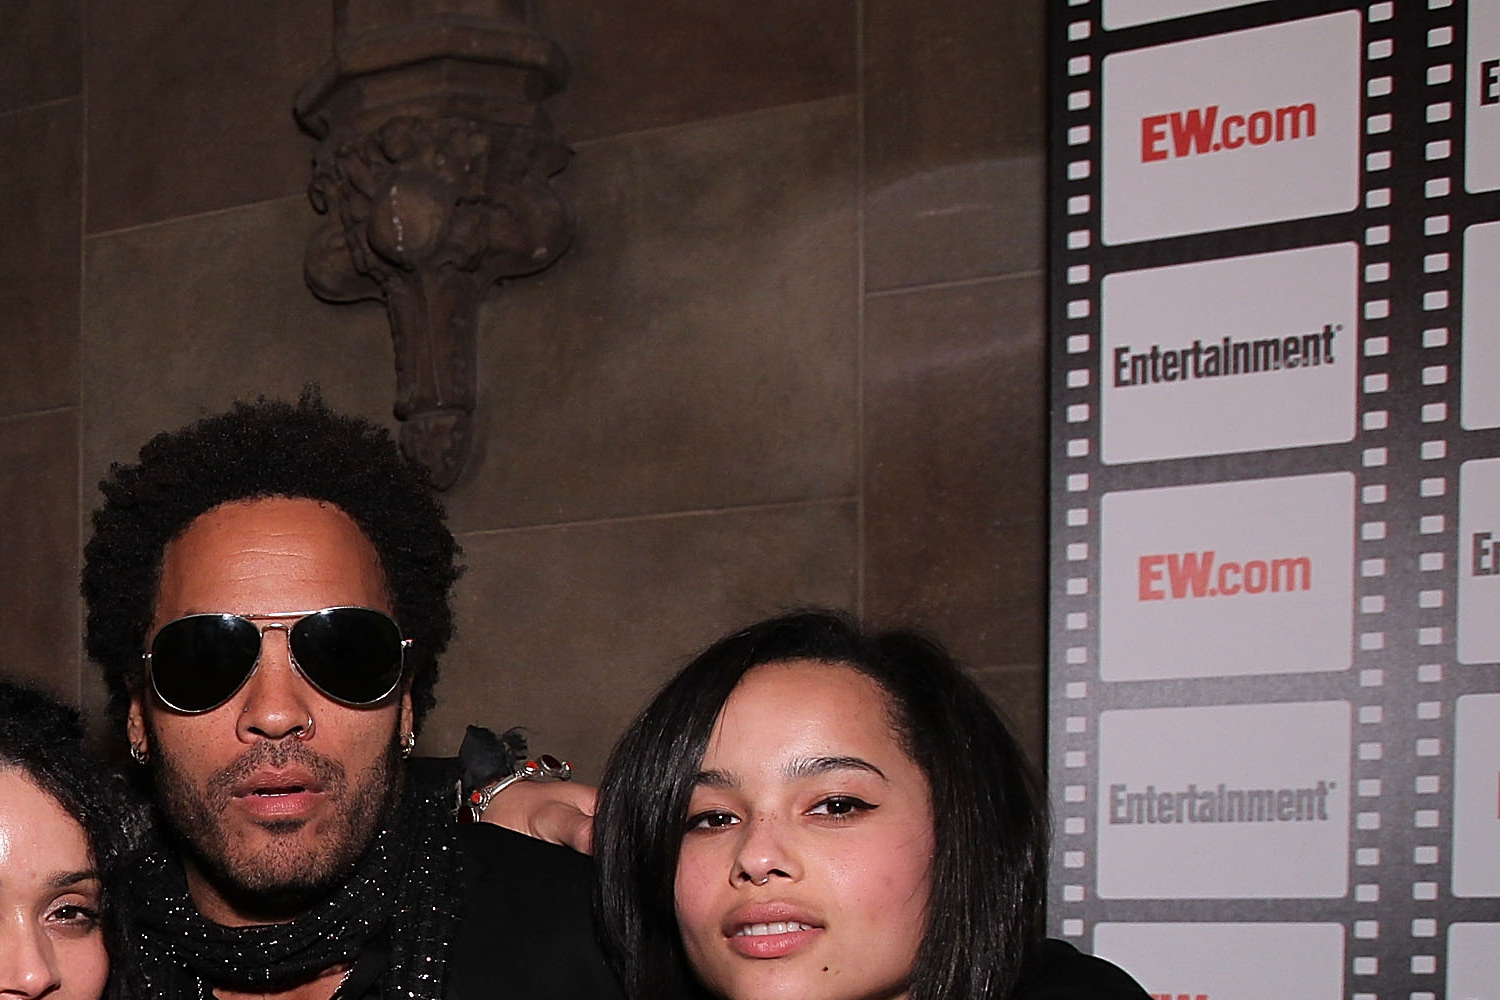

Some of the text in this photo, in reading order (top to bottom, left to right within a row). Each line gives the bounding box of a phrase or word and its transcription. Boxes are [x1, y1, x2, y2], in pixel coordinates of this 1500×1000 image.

[1141, 102, 1316, 162] EW.com
[1113, 324, 1335, 388] Entertainment
[1139, 550, 1311, 601] EW.com
[1109, 780, 1329, 825] Entertainment
